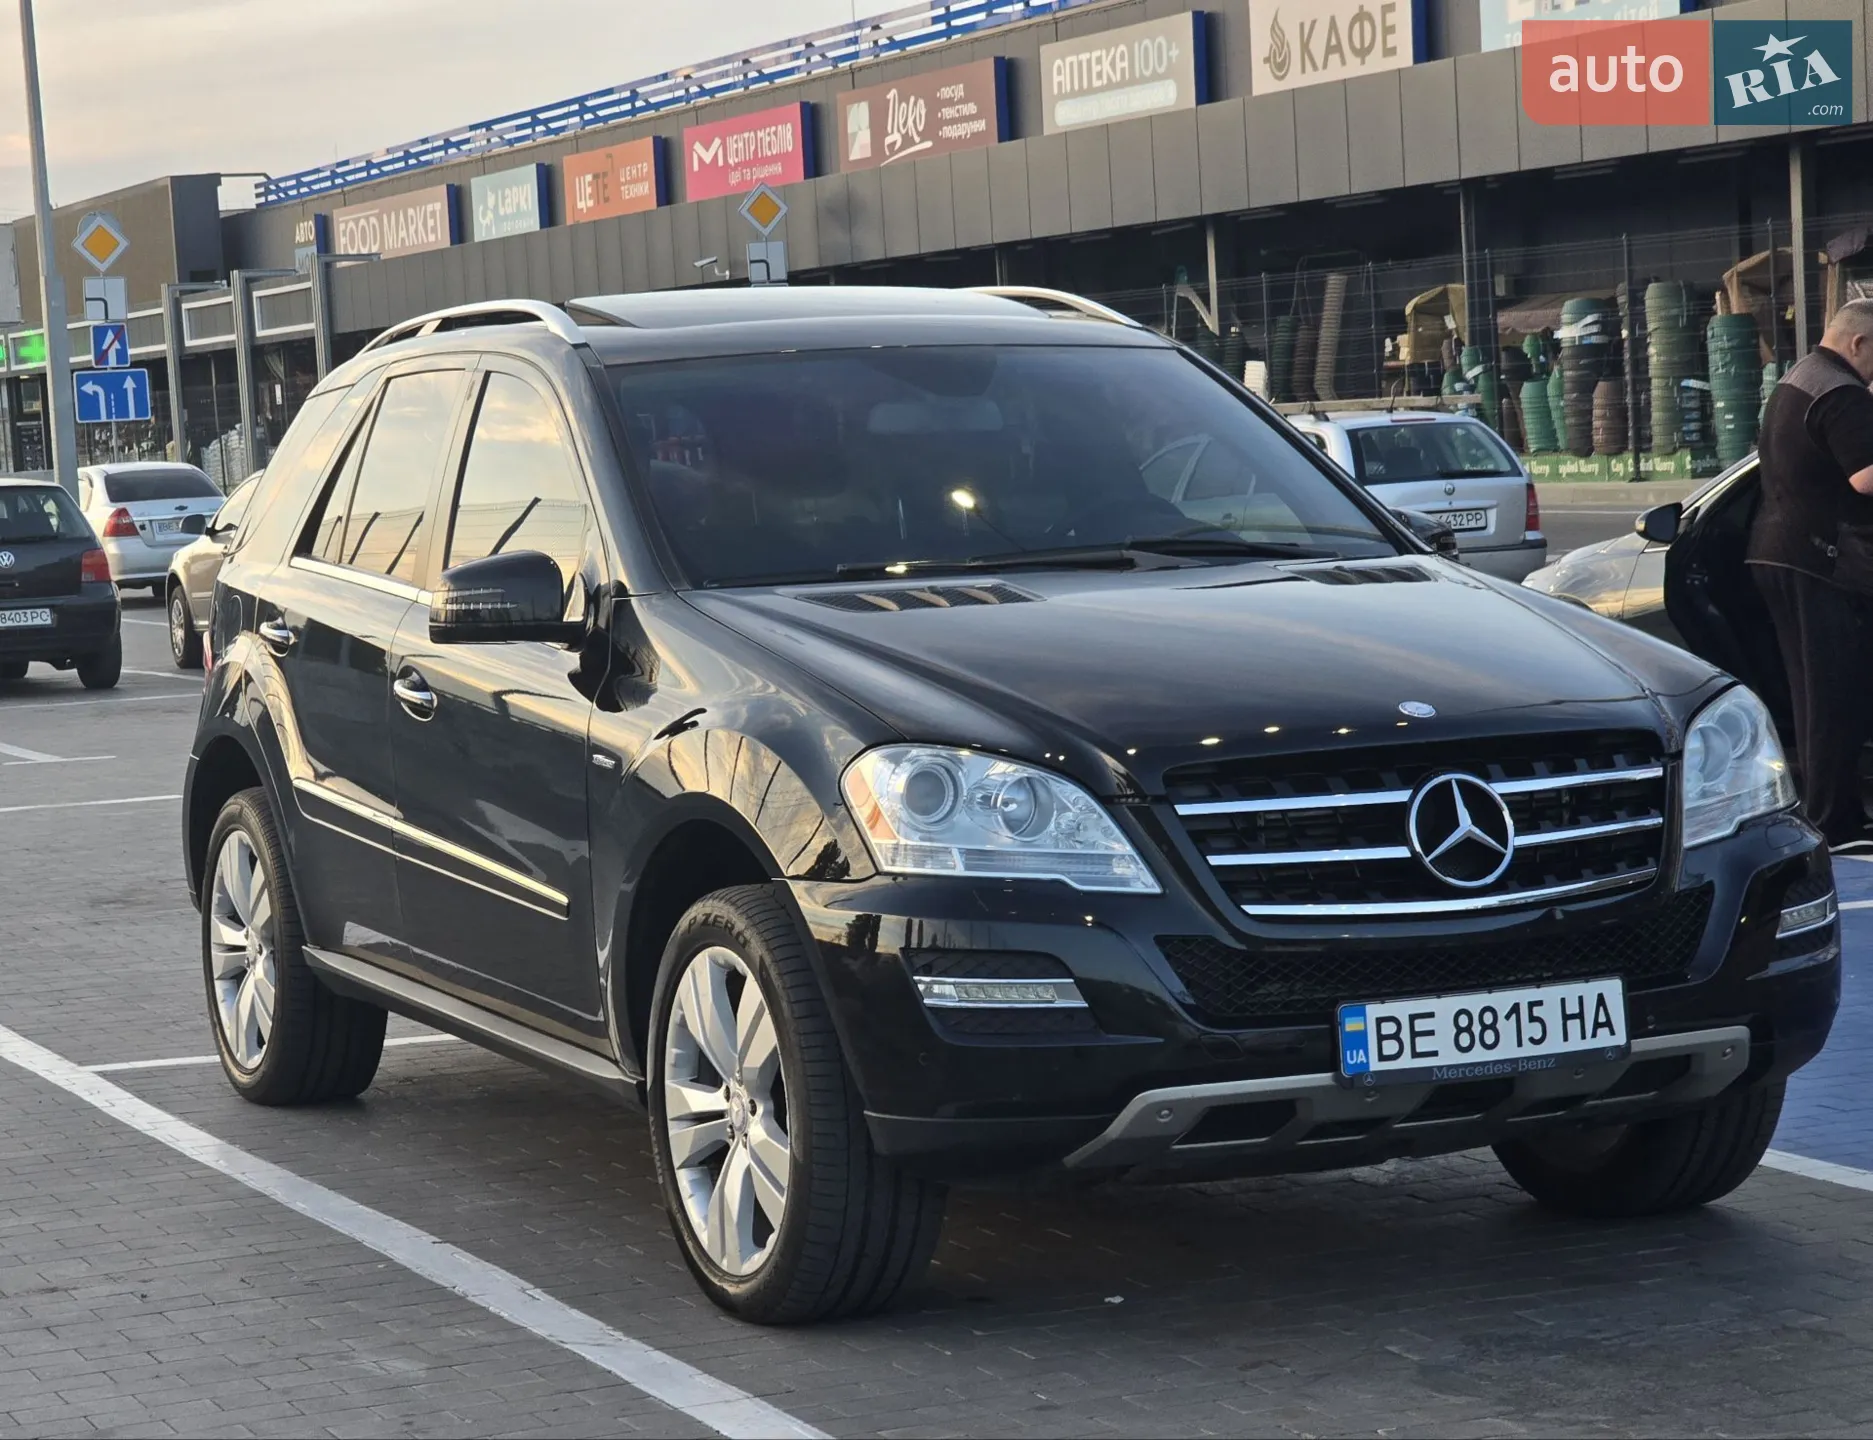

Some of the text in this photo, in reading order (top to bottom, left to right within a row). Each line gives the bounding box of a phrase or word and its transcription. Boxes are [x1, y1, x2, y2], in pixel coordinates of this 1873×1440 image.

[1300, 3, 1397, 75] КАФЕ
[1053, 35, 1180, 96] АПТЕКА 100+
[940, 83, 965, 102] посуд
[885, 88, 927, 155] Деко
[726, 122, 793, 166] ЦЕНТР МЕБЛІВ
[620, 161, 649, 183] ЦЕНТР
[742, 168, 751, 181] та
[620, 181, 650, 200] ТЕХНІКИ
[295, 219, 315, 245] АВТО
[339, 202, 442, 255] FOOD MARKET
[0, 611, 29, 625] 8403
[1375, 992, 1616, 1063] BE 8815 HA
[1346, 1049, 1367, 1065] UA
[1432, 1057, 1556, 1081] Mercedes-Benz
